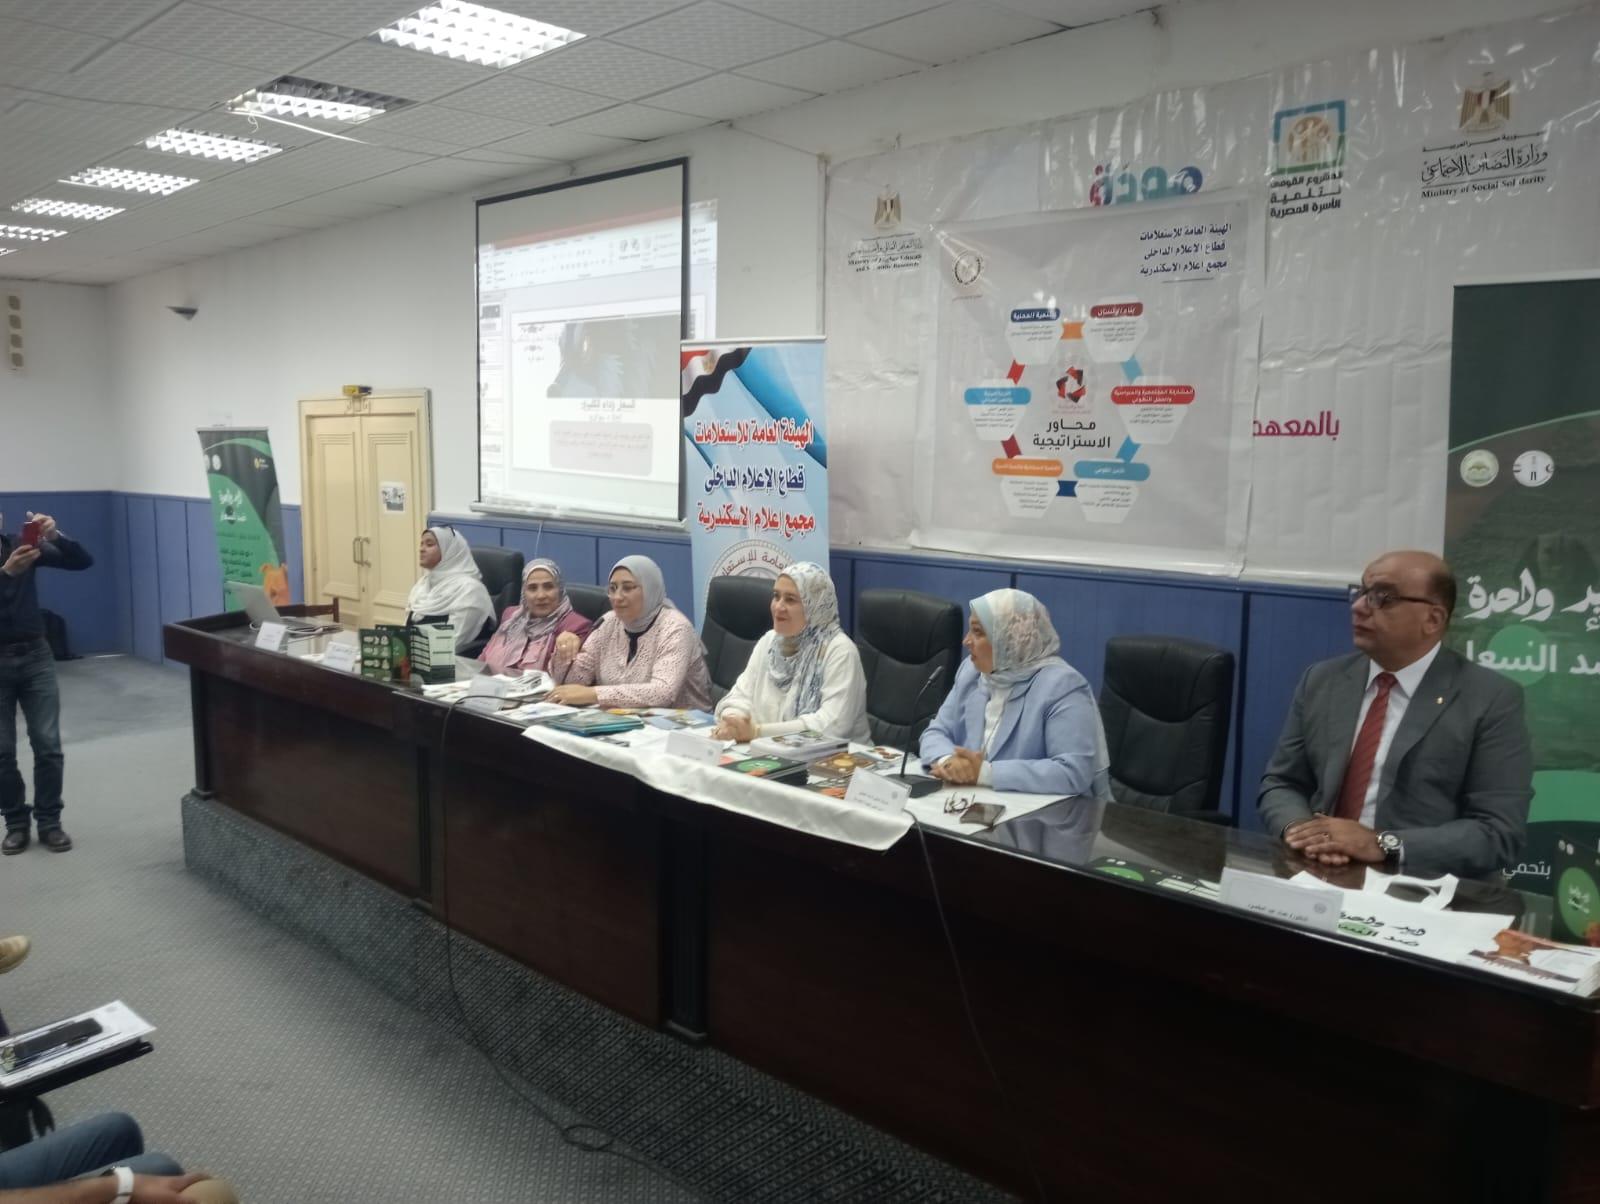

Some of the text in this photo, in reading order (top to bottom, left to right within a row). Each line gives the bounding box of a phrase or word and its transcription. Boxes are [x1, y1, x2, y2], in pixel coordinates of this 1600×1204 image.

[1516, 144, 1549, 169] وزارة
[1421, 174, 1546, 199] Ministry of Social Soldarity
[1270, 198, 1342, 218] الأسرة المصرية
[1184, 225, 1207, 237] العامة
[1209, 223, 1232, 236] الهيئة
[1205, 240, 1226, 255] قطاع
[1206, 260, 1227, 273] مجمع
[751, 420, 782, 444] العامة
[783, 418, 814, 449] الهيئة
[1046, 418, 1097, 434] محاور
[1033, 435, 1111, 450] الاستراتيجية
[742, 467, 776, 495] الإعلام
[779, 466, 805, 496] قطاع
[784, 512, 815, 538] مجمع
[1464, 567, 1555, 622] واحدة
[1502, 861, 1551, 880] بتحمي
